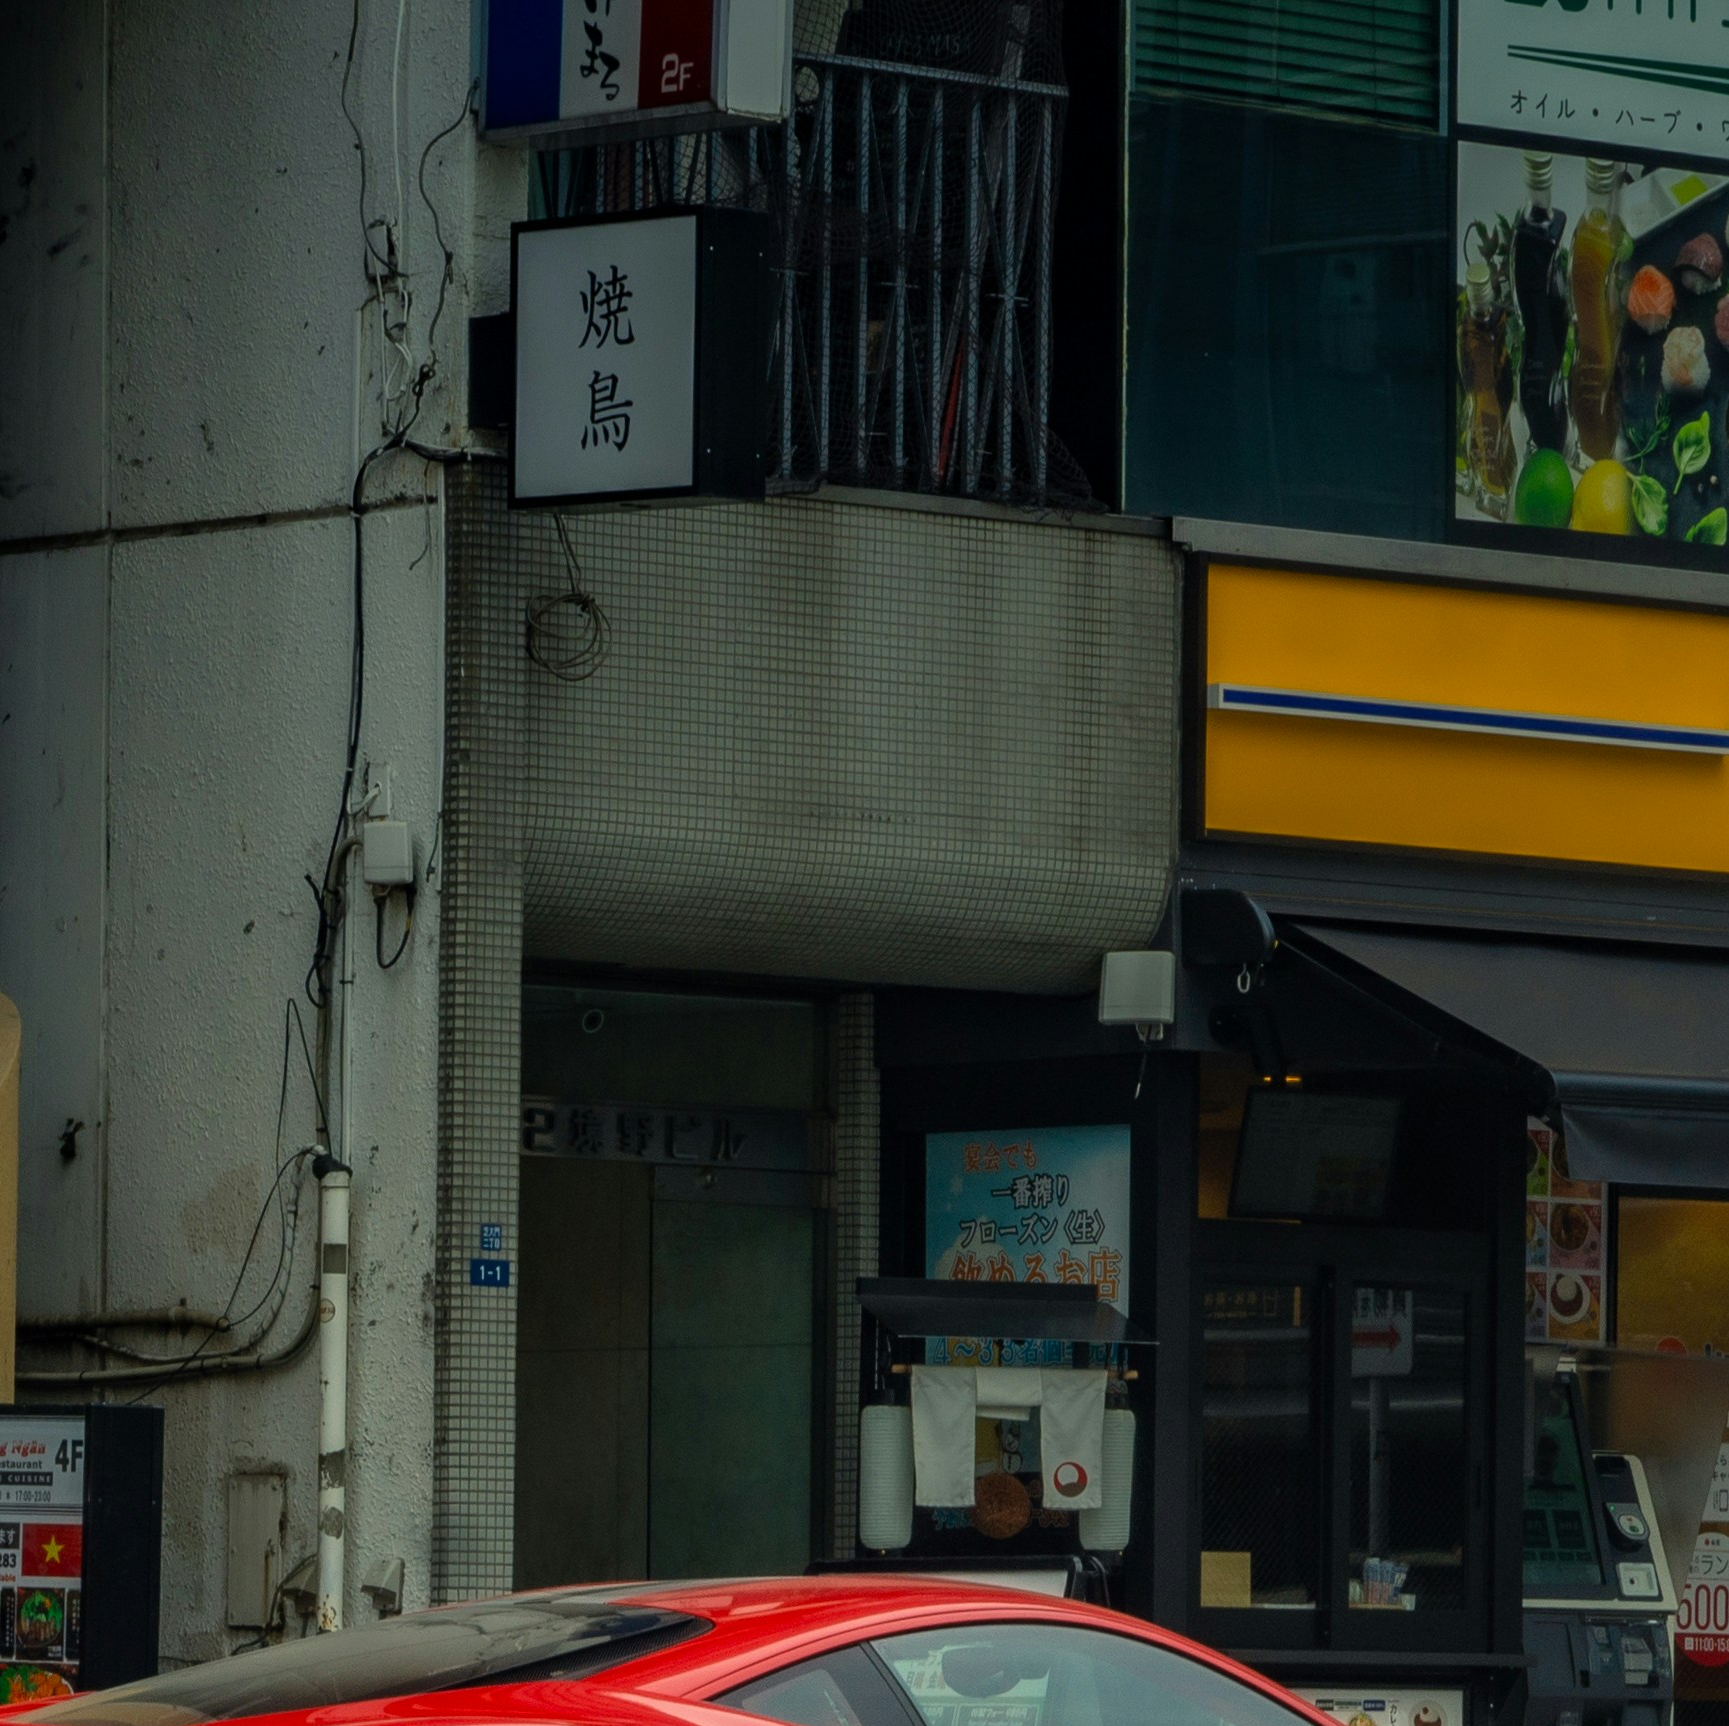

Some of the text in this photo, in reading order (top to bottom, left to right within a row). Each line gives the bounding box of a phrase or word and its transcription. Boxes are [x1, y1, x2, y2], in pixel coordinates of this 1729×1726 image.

[580, 0, 620, 100] まる
[660, 53, 694, 93] 2F
[578, 264, 634, 453] 焼鳥
[963, 1137, 1039, 1173] 宴会でも
[991, 1173, 1070, 1209] 一番搾り
[479, 1264, 501, 1281] 1-1
[951, 1247, 1122, 1302] 飲めるお店
[55, 1439, 83, 1472] 4F
[7, 1475, 51, 1483] CUISINE
